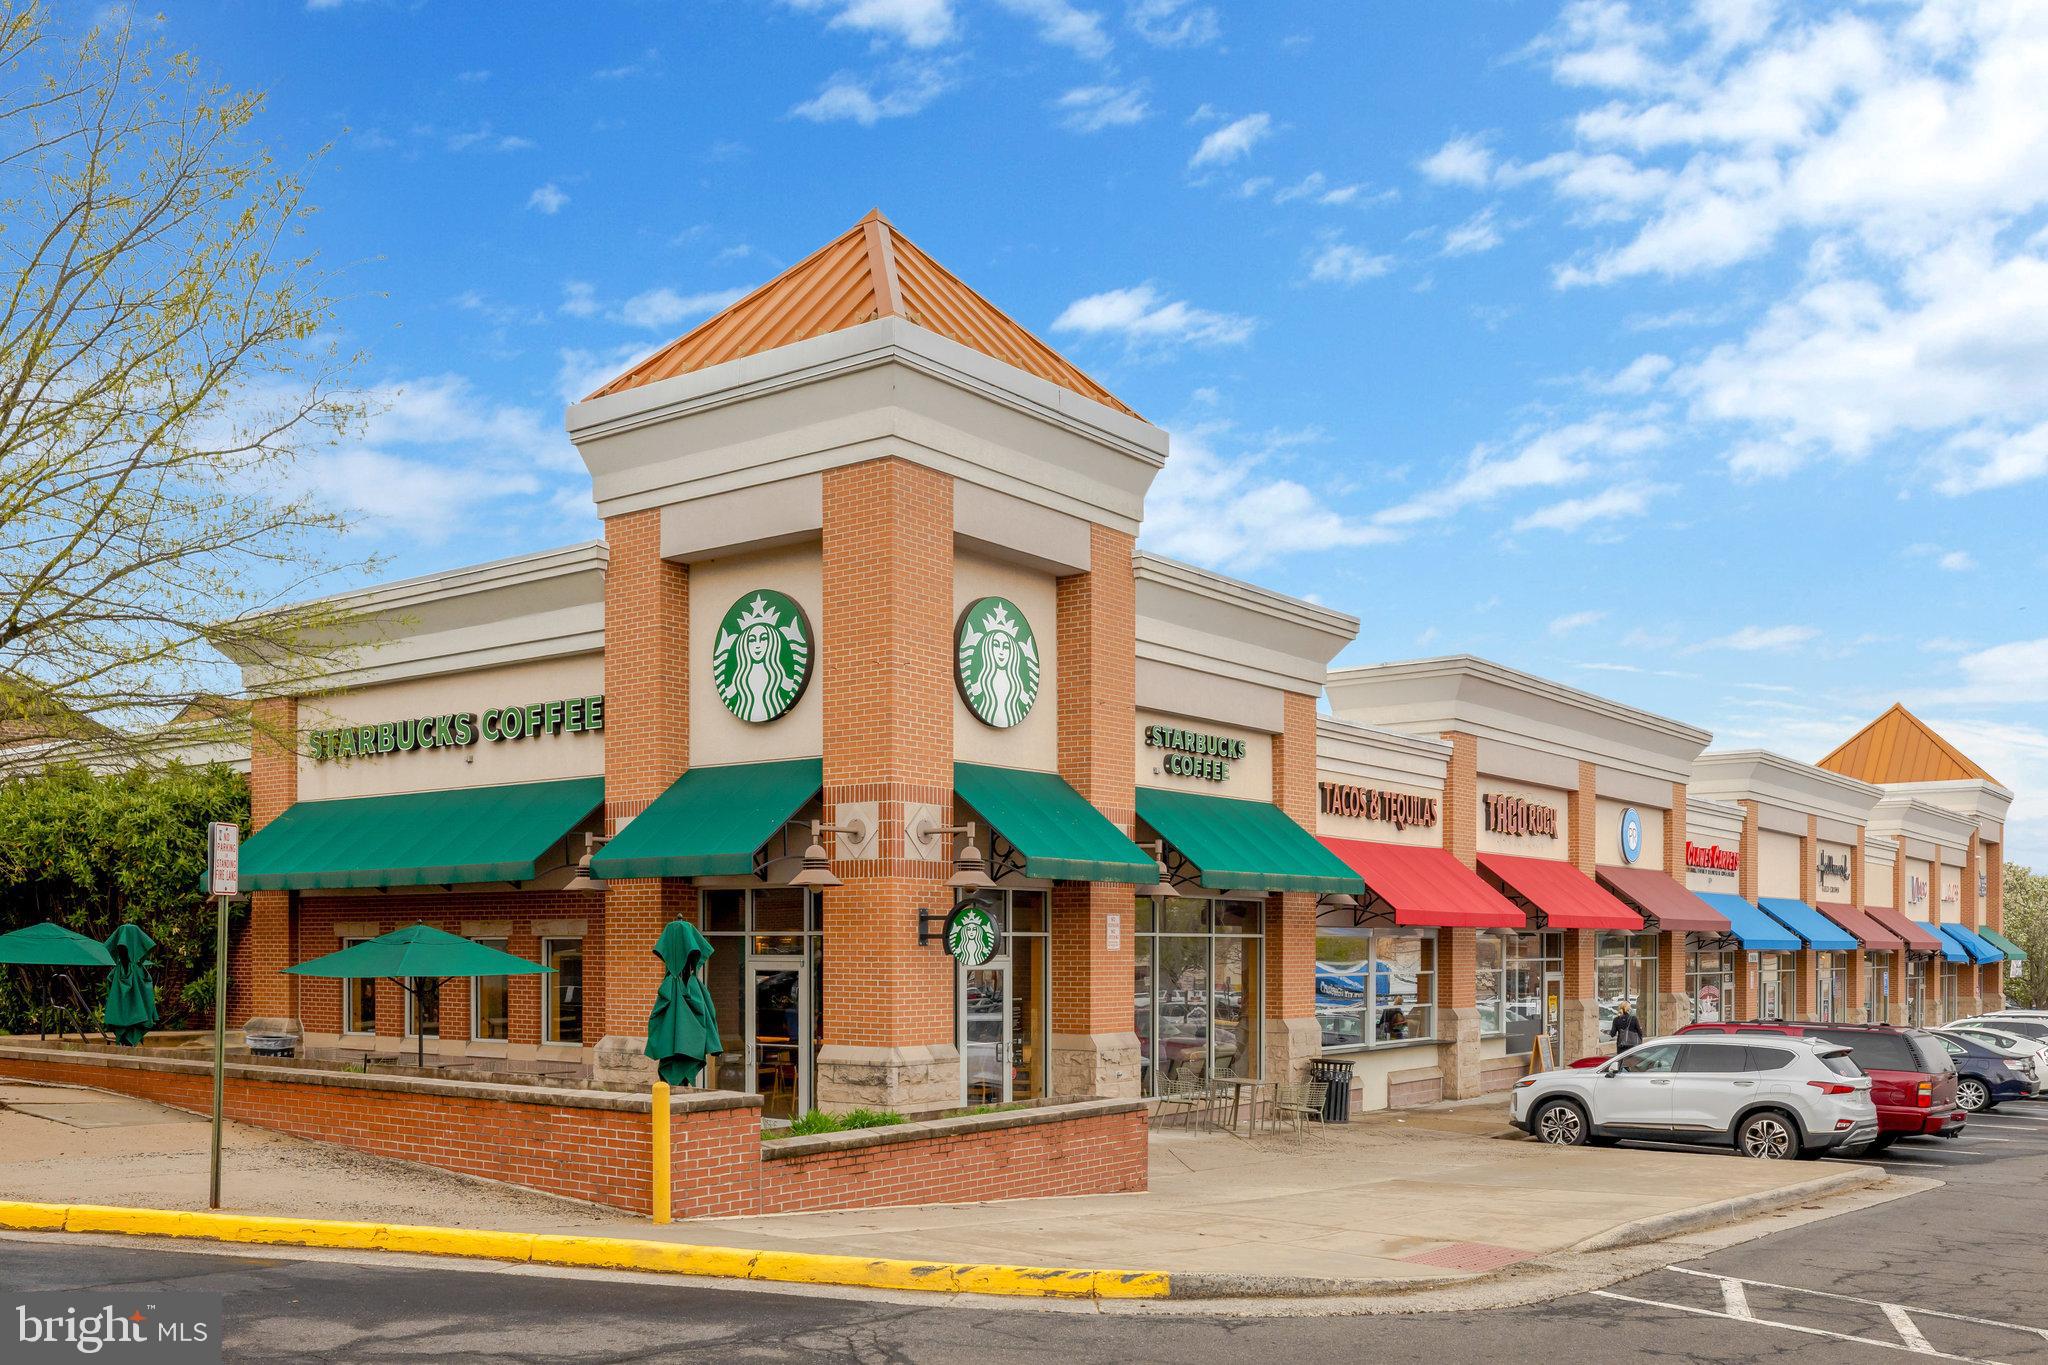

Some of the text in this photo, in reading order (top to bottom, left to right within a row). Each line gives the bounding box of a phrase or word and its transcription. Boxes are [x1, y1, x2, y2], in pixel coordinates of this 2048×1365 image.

[308, 694, 605, 759] STARBUCKS COFFEE
[1146, 725, 1246, 759] STARBUCKS
[1164, 753, 1231, 781] COFFEE
[1319, 782, 1438, 831] TACOS & TEQUILAS
[1483, 794, 1558, 839] TACO ROCK
[216, 842, 236, 853] PARKING
[223, 832, 230, 841] NO
[216, 859, 236, 869] STANDING
[1711, 845, 1740, 871] CARPETS
[1816, 850, 1850, 886] Hallmark
[215, 869, 237, 881] FIRE LANE
